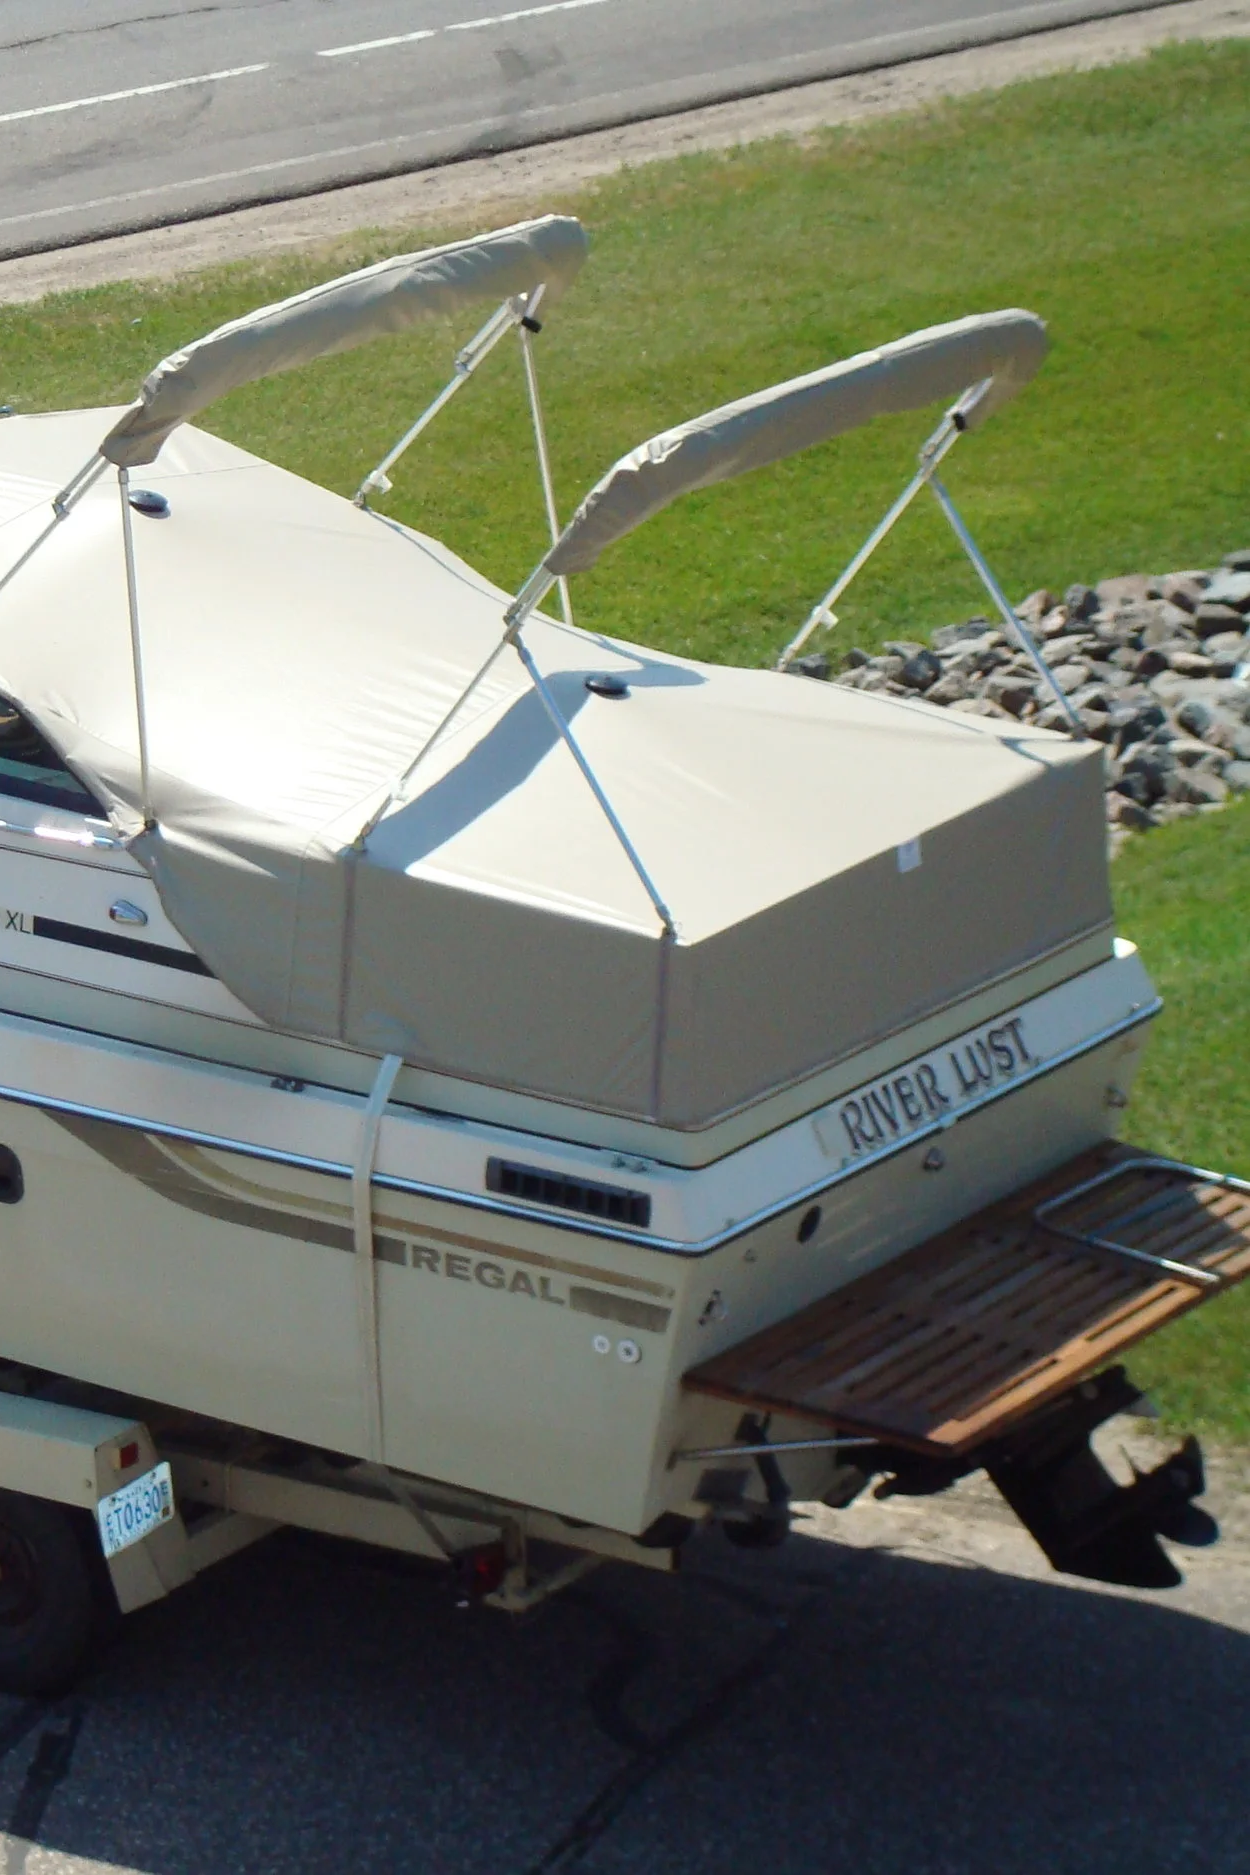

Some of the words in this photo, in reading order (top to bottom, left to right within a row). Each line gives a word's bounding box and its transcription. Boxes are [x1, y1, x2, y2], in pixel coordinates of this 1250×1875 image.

[5, 909, 32, 935] XL
[839, 1062, 951, 1152] RIVER
[950, 1016, 1033, 1093] LUST
[410, 1244, 566, 1306] REGAL
